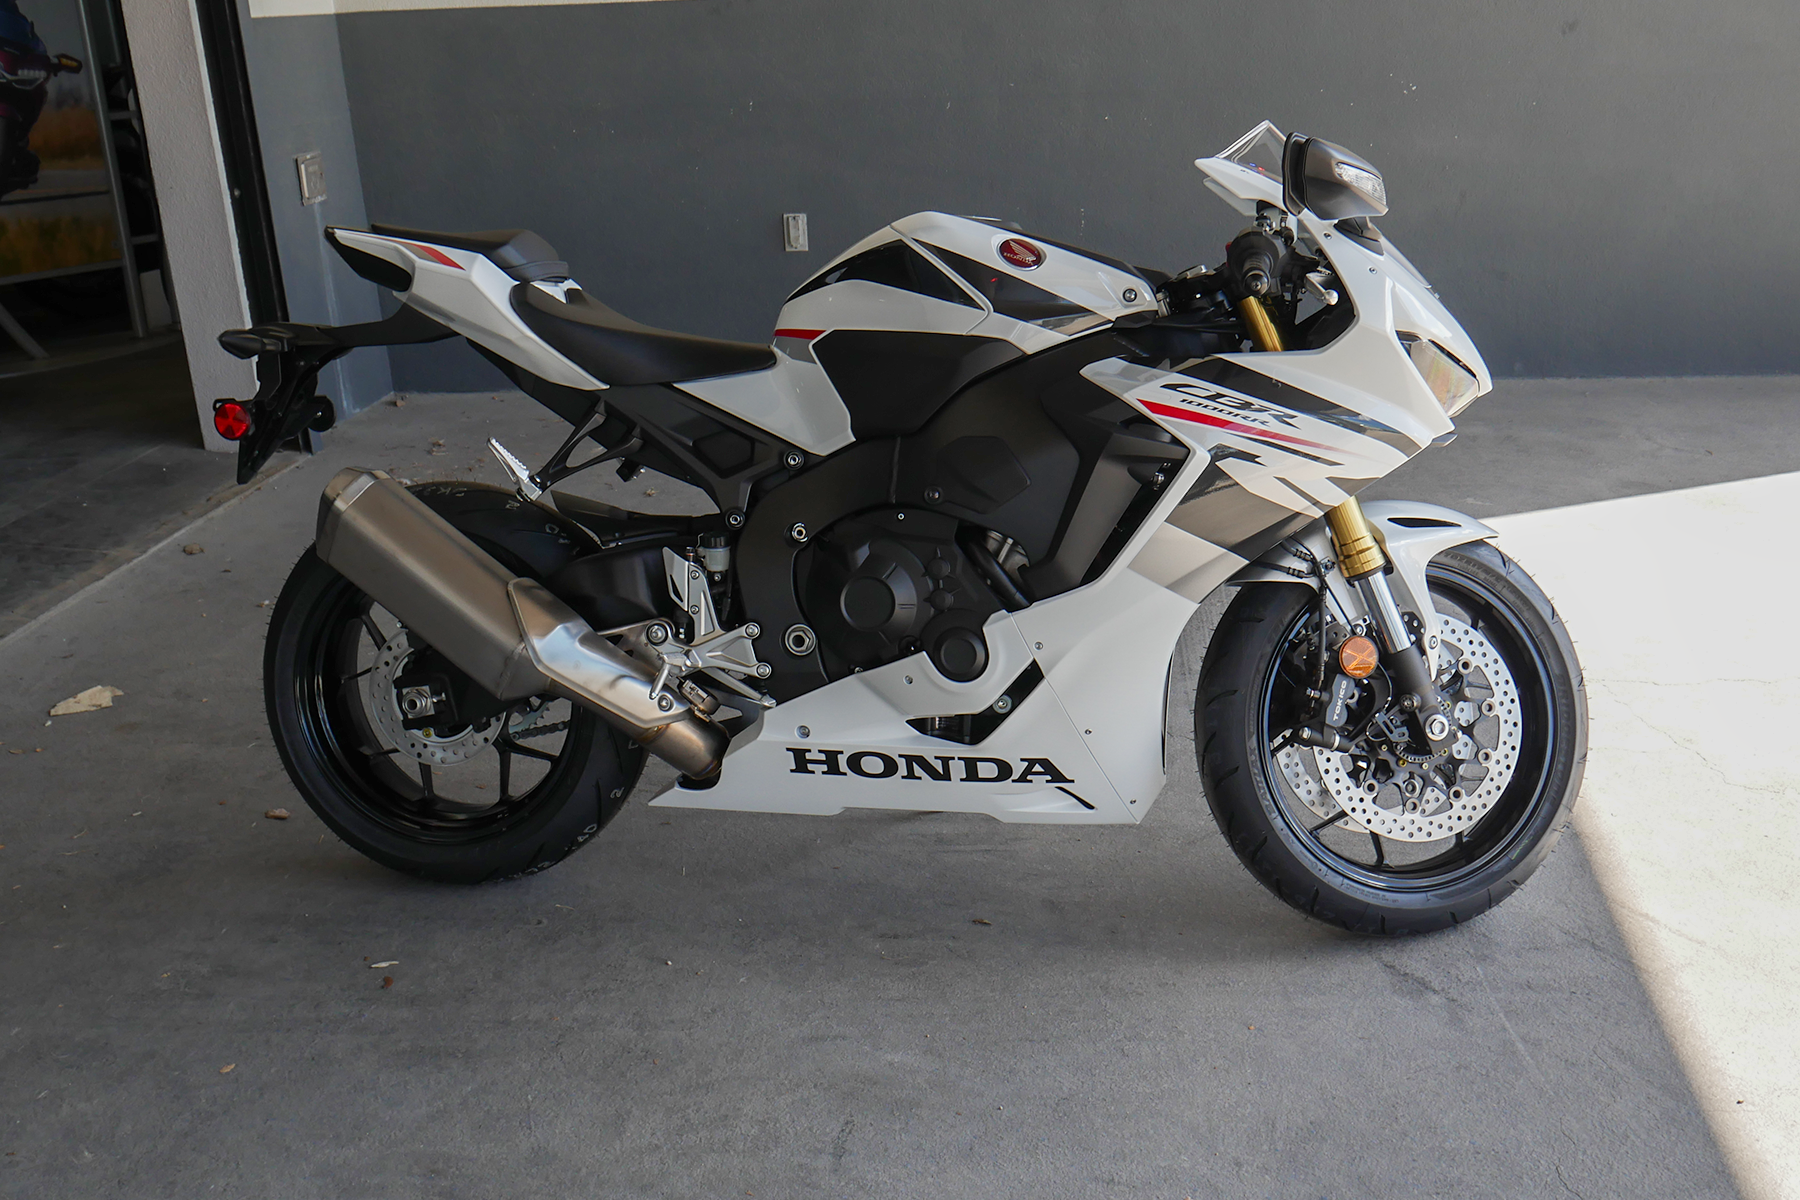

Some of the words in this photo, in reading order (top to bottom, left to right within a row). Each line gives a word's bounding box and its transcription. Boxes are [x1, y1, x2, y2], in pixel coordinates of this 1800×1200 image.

[1159, 383, 1301, 430] CBR
[1179, 398, 1271, 427] 1000RR
[1332, 679, 1348, 722] TOKICO
[785, 747, 1075, 784] HONDA
